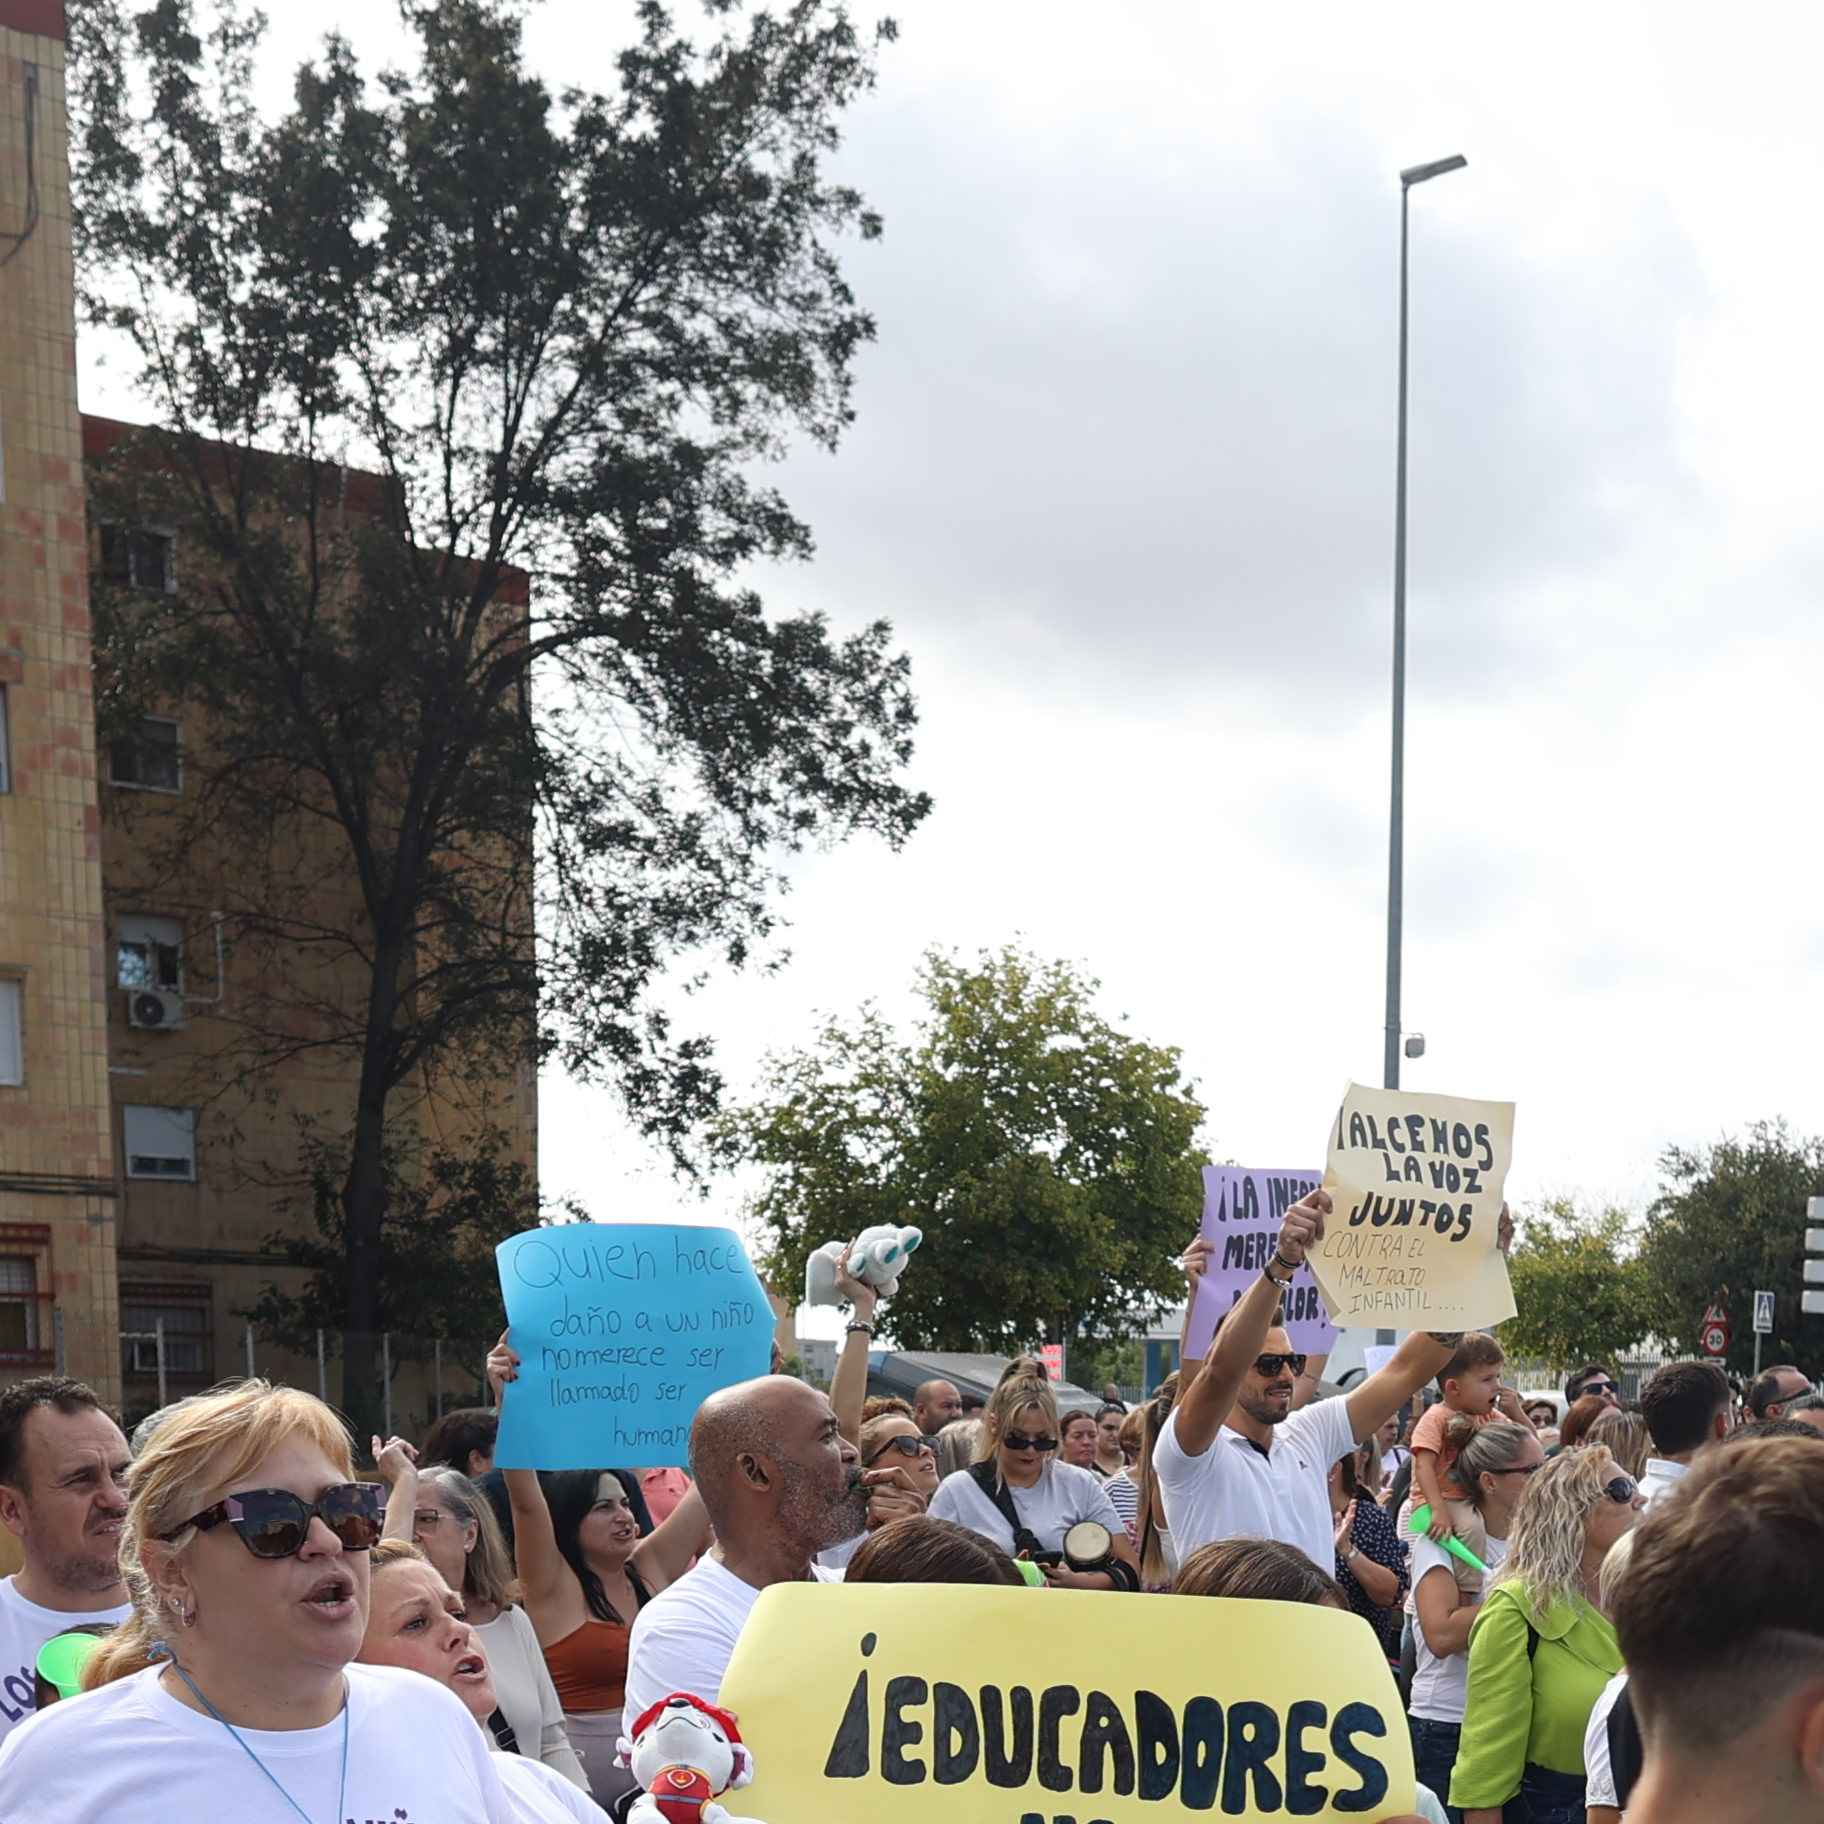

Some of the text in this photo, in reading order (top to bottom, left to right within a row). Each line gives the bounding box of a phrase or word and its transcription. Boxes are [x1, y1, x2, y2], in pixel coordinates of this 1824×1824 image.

[1382, 1152, 1483, 1194] LA VOZ
[1349, 1191, 1473, 1243] JUNTOS
[514, 1235, 745, 1289] Quien hace
[1323, 1230, 1407, 1260] CONTRA
[550, 1295, 623, 1338] daño
[635, 1311, 654, 1333] a
[712, 1300, 755, 1330] niño
[1709, 1334, 1723, 1347] 30
[686, 1346, 725, 1373] ser
[655, 1382, 688, 1401] ser
[613, 1416, 690, 1447] human
[824, 1632, 1389, 1816] ¡EDUCADORES
